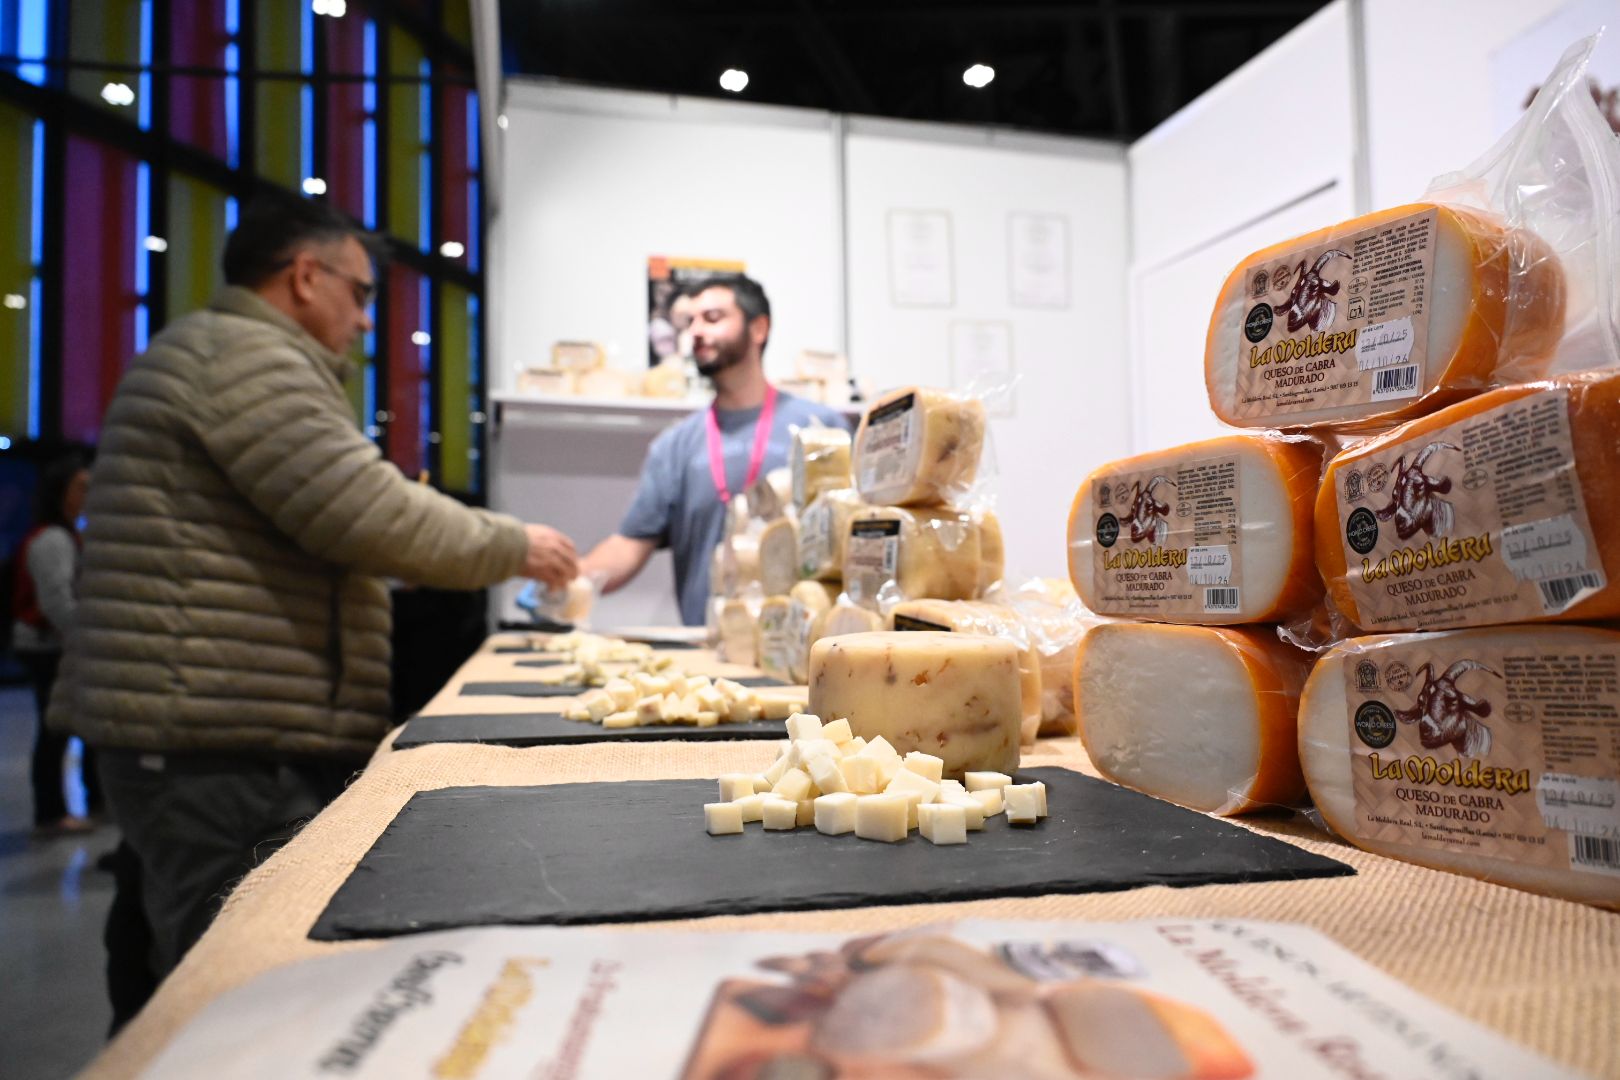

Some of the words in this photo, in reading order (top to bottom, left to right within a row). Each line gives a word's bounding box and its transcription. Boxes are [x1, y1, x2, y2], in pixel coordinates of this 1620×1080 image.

[1250, 346, 1272, 368] La
[1264, 366, 1293, 380] QUESO
[1294, 367, 1304, 375] DE
[1305, 358, 1336, 372] CABRA
[1275, 373, 1325, 389] MADURADO
[1103, 550, 1121, 570] La
[1362, 557, 1388, 584] La
[1116, 573, 1140, 583] QUESO
[1148, 572, 1172, 580] CABRA
[1126, 583, 1164, 591] MADURADO
[1386, 578, 1422, 596] QUESO
[1424, 579, 1436, 588] DE
[1437, 568, 1476, 586] CABRA
[1405, 585, 1467, 606] MADURADO
[1369, 752, 1403, 780] La
[1396, 788, 1440, 803] QUESO
[1443, 795, 1457, 805] DE
[1458, 794, 1504, 811] CABRA
[1416, 804, 1490, 823] MADURADO
